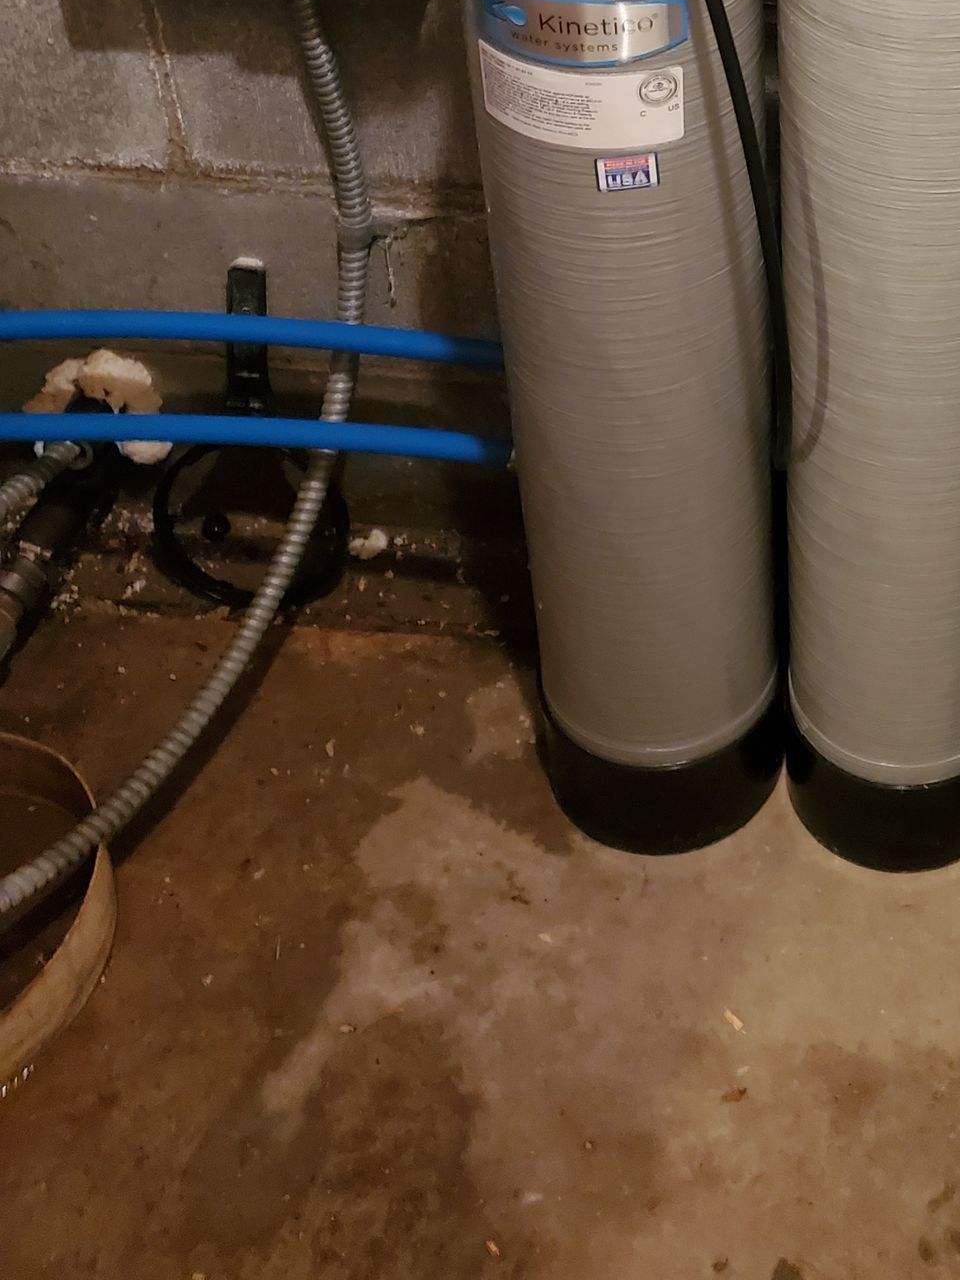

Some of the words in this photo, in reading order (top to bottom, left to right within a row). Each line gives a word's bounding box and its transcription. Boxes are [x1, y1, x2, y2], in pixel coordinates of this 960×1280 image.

[539, 12, 654, 37] Kinetico
[511, 31, 548, 47] water
[555, 40, 618, 53] systems
[668, 103, 680, 112] US
[607, 169, 650, 187] USA
